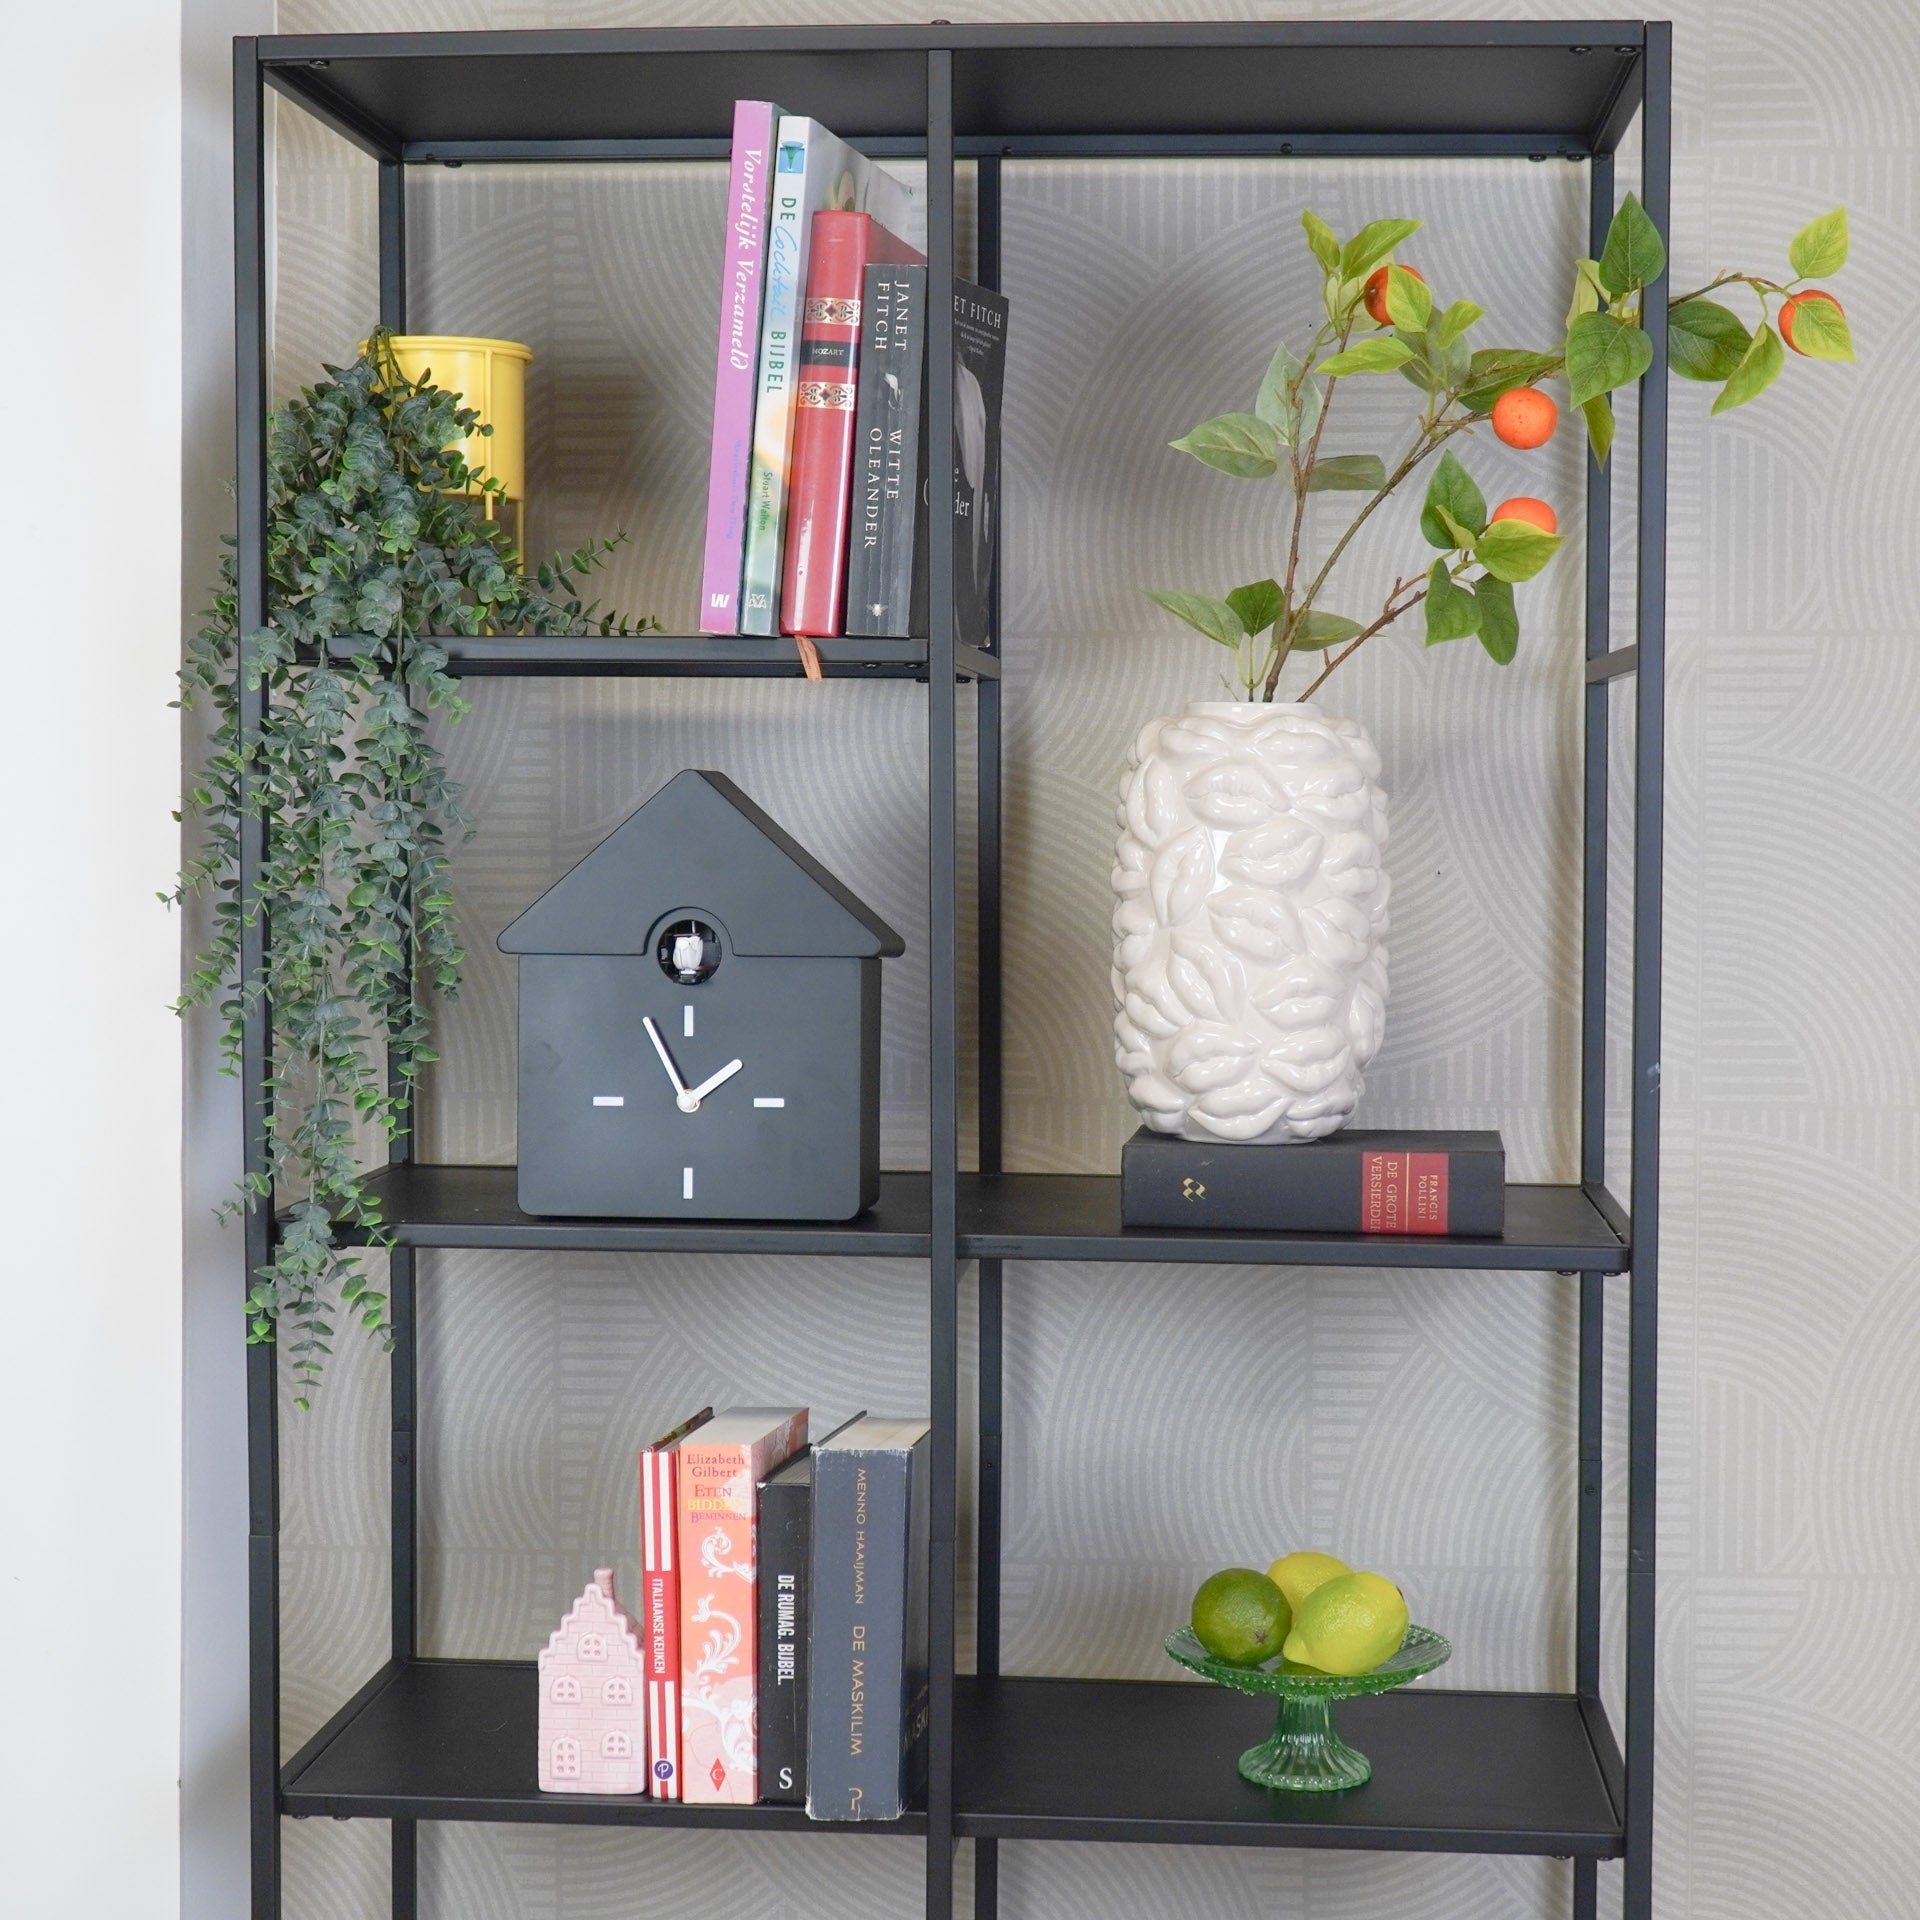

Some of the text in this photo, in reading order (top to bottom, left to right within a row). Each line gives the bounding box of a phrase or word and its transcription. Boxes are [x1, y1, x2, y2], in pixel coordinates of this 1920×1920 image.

[779, 197, 797, 221] DE
[730, 149, 762, 371] Vorstelijk Verzameld
[874, 282, 890, 350] FITCH
[894, 280, 910, 351] JANET
[970, 302, 1002, 329] FITCH
[766, 331, 787, 393] BIJBEL
[812, 347, 844, 356] MOZART
[864, 428, 883, 549] OLEANDER
[886, 429, 902, 500] WITTE
[1385, 1162, 1398, 1229] DE GROTE
[1418, 1175, 1427, 1219] POLLINI
[1429, 1175, 1439, 1221] FRANCIS
[687, 1454, 745, 1465] Elizabeth
[691, 1466, 738, 1478] Gilbert
[854, 1468, 866, 1604] MENNO HAAIJMAN
[652, 1578, 666, 1674] ITALIAANSE KEUKEN
[777, 1574, 795, 1686] DE RUMAG. BIJBEL.
[850, 1626, 865, 1755] DE MASKILIM
[779, 1767, 793, 1789] S
